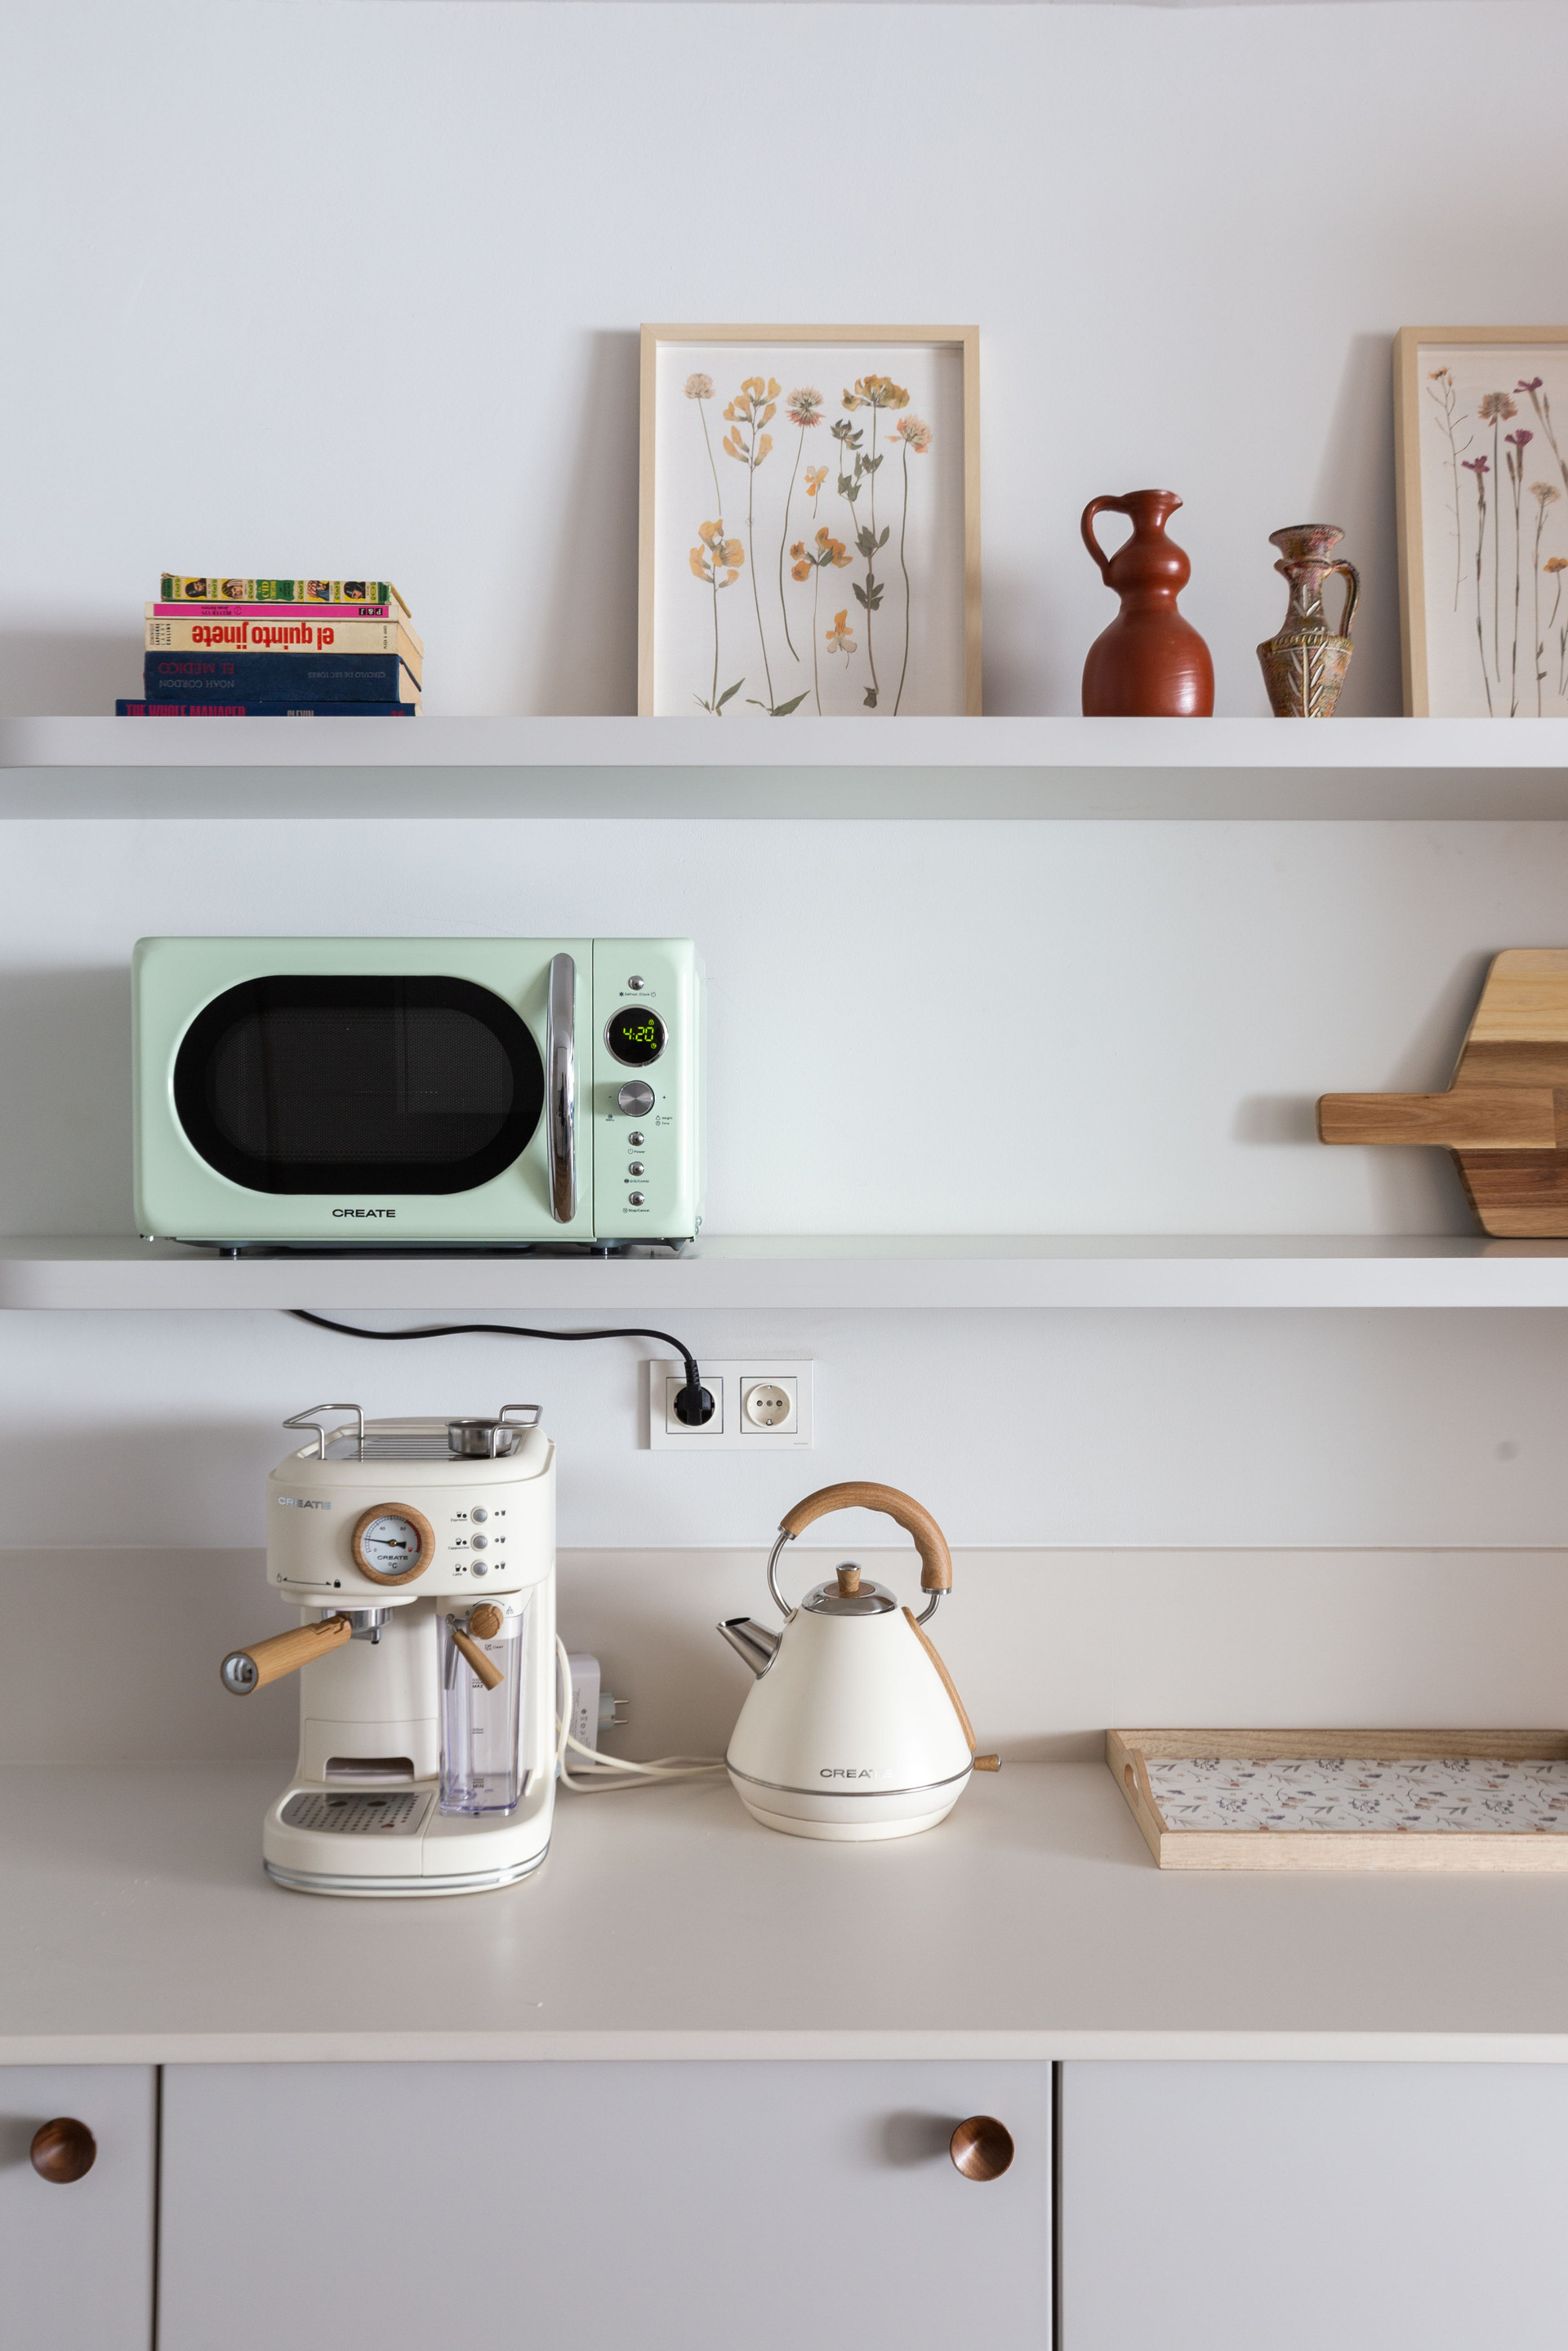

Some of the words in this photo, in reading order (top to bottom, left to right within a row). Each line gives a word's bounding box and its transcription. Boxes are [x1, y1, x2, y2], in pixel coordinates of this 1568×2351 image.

[192, 622, 249, 649] jinete
[252, 622, 313, 649] quinto
[317, 628, 334, 650] el
[158, 662, 216, 675] MÉDICO
[220, 662, 234, 675] EL
[159, 679, 203, 688] GORDON
[206, 679, 235, 688] NOAH
[126, 704, 146, 716] THE
[623, 1026, 654, 1042] 4:20
[332, 1209, 396, 1218] CREATE
[278, 1497, 332, 1510] CREATE
[820, 1769, 893, 1779] CREAE
